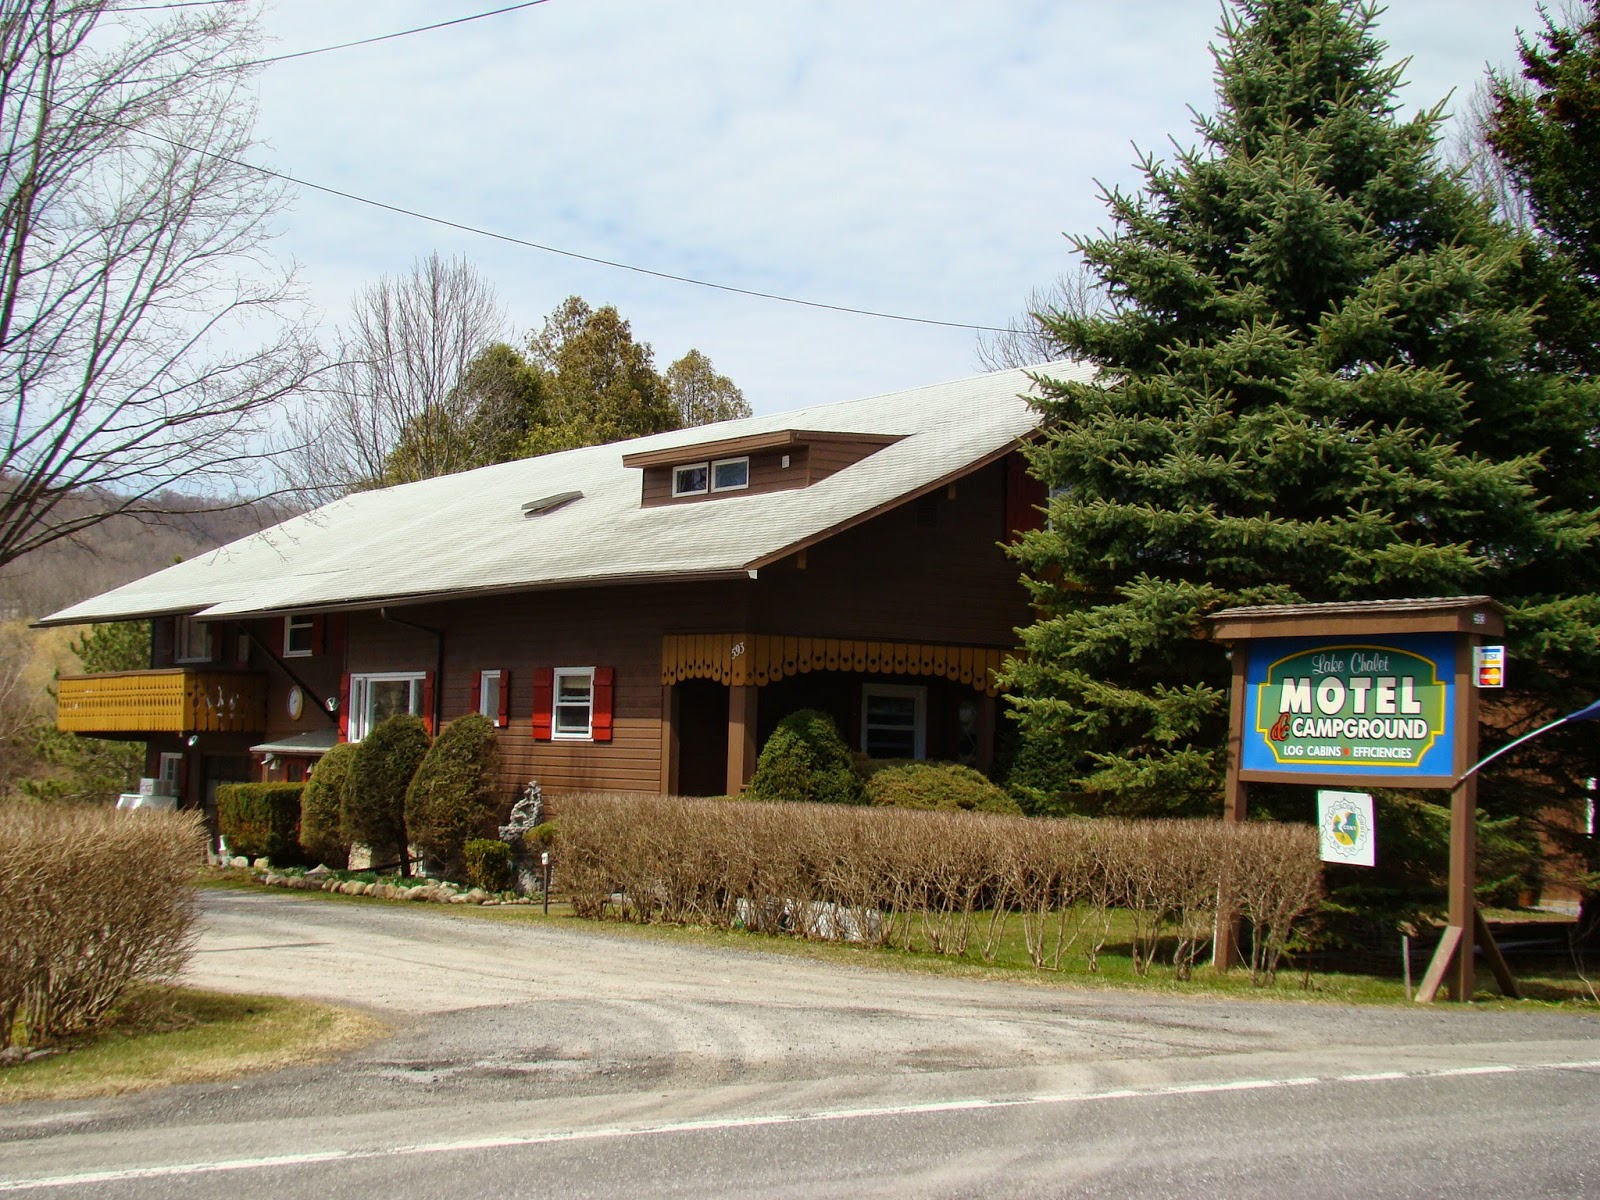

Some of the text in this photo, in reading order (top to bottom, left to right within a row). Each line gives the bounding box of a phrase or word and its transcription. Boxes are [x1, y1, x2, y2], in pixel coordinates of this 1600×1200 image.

[731, 642, 745, 660] 593
[1311, 652, 1390, 675] Lake Chalet
[1279, 676, 1422, 715] MOTEL
[1270, 711, 1428, 741] & CAMPGROUND
[1283, 745, 1412, 759] LOG CABINS EFFICIENCIES
